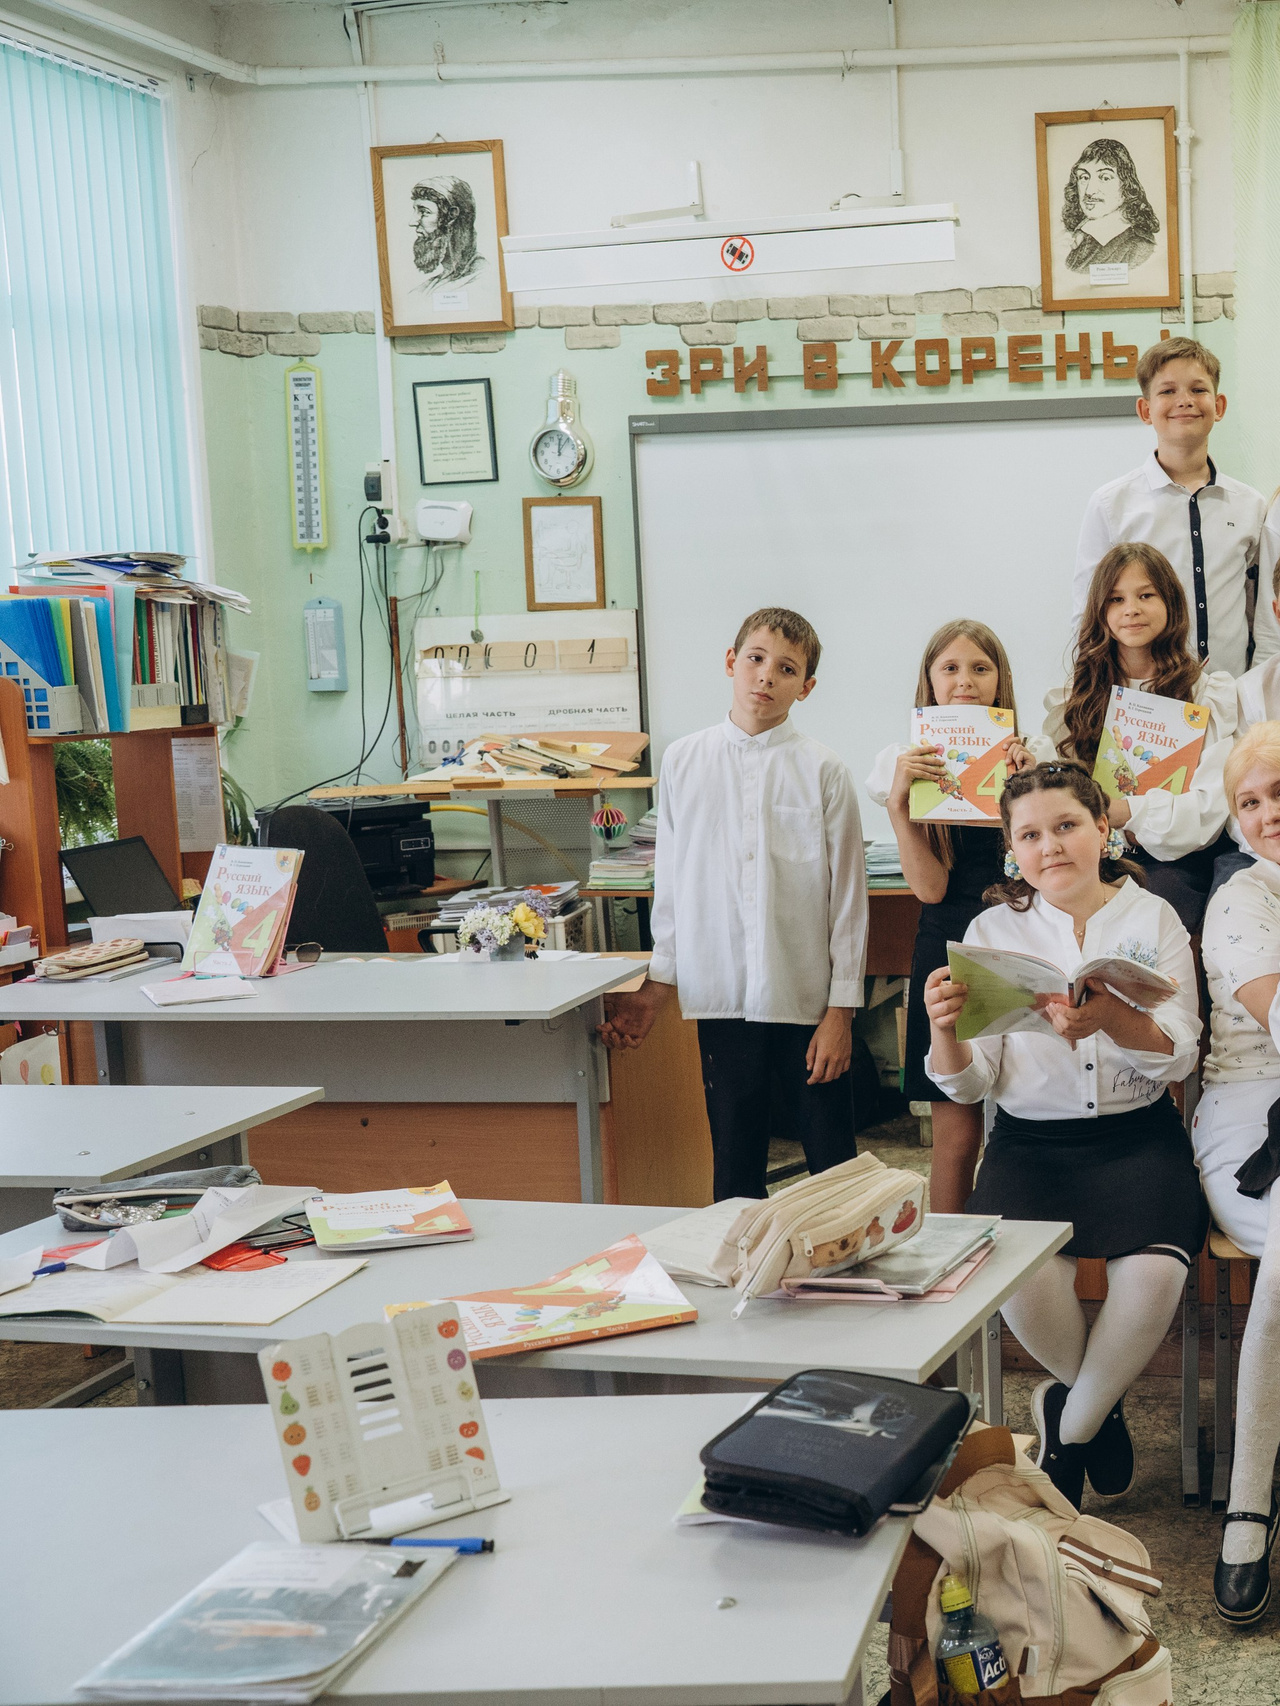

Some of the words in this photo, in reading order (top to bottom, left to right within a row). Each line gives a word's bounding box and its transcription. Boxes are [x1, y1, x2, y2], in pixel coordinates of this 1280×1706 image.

[645, 345, 769, 397] ЗРИ
[803, 342, 838, 390] В
[587, 638, 596, 664] 1
[446, 711, 478, 719] ЦЕЛАЯ
[482, 710, 516, 718] ЧАСТЬ
[547, 707, 593, 716] ДРОБНАЯ
[1114, 708, 1166, 733] Русский
[920, 723, 975, 737] Русский
[976, 760, 1008, 804] 4
[216, 866, 262, 883] Русский
[241, 910, 278, 958] 4
[414, 1214, 460, 1231] 4
[606, 1325, 623, 1333] Часть
[523, 1337, 551, 1348] Русский
